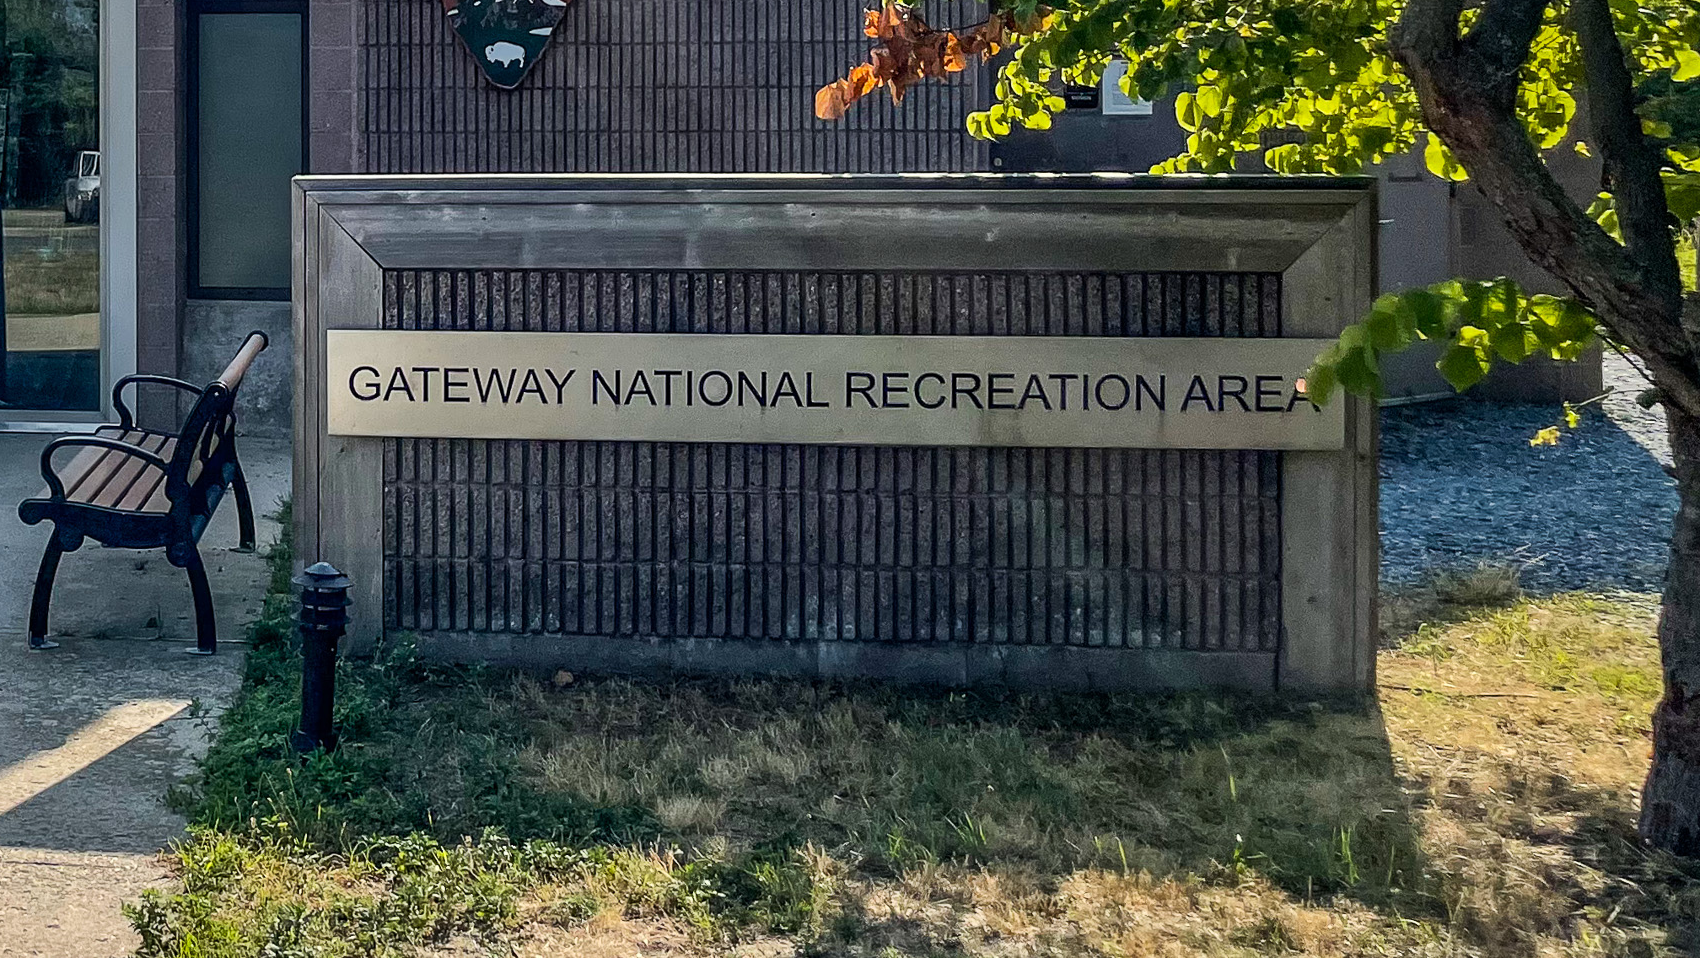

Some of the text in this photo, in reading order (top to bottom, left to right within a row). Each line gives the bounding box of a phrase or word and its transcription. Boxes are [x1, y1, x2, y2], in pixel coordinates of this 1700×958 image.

[347, 365, 576, 405] GATEWAY
[591, 369, 830, 409] NATIONAL
[845, 372, 1166, 412] RECREATION
